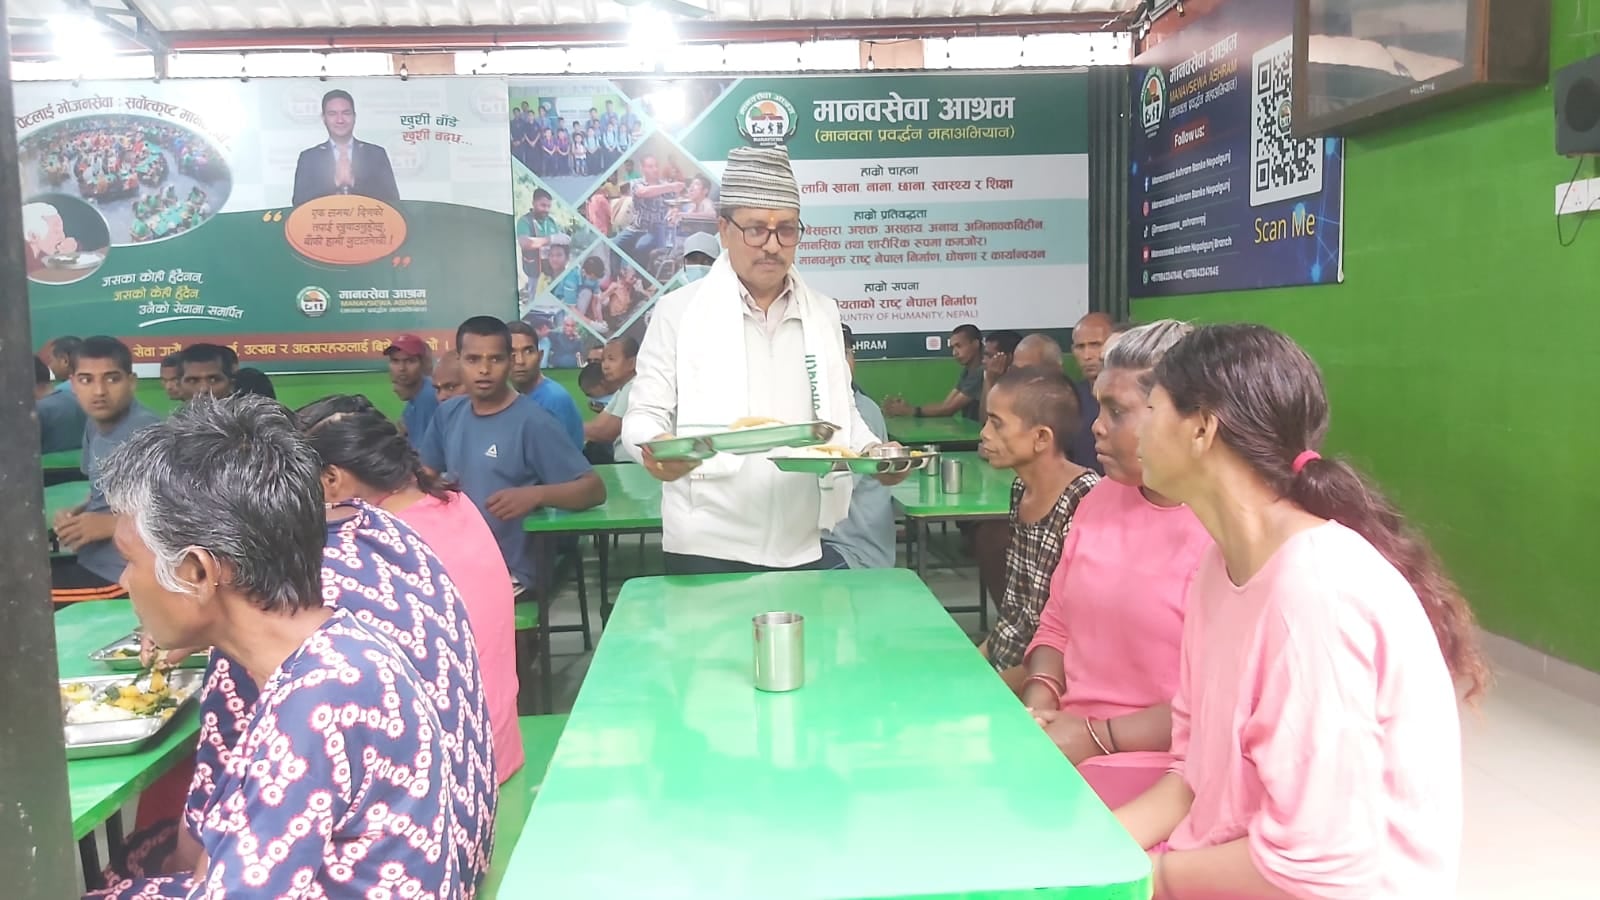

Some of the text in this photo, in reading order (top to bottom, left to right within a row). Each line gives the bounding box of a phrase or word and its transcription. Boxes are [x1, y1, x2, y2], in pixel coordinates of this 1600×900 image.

[56, 93, 114, 115] भोजनसेवा
[813, 91, 1016, 123] मानवसेवा आश्रम
[400, 112, 431, 129] खुशी
[402, 128, 430, 145] खुशी
[815, 124, 1015, 144] (मानवता प्रवर्द्धन महाअभियान)
[1174, 130, 1194, 148] Follow
[860, 164, 919, 177] हाम्रो चाहना
[801, 180, 828, 194] लागि
[974, 179, 982, 190] र
[986, 177, 1013, 190] शिक्षा
[853, 208, 877, 221] हाम्रो
[805, 224, 842, 236] बेसहारा
[1254, 211, 1316, 244] Scan Me
[799, 238, 841, 251] मानसिक
[845, 240, 864, 249] तथा
[867, 236, 910, 250] शारीरिक
[875, 252, 904, 264] नेपाल
[946, 250, 977, 262] घोषणा
[980, 252, 987, 261] र
[991, 248, 1046, 261] कार्यान्वयन
[139, 269, 165, 283] कोही
[338, 287, 427, 300] मानवसेवा आश्रम
[864, 280, 919, 293] हाम्रो सपना
[906, 296, 937, 308] नेपाल
[942, 294, 977, 307] निर्माण
[207, 304, 244, 319] समर्पित
[877, 312, 889, 321] OF
[133, 343, 155, 357] सेवा
[244, 343, 276, 356] उत्सव
[280, 343, 289, 354] र
